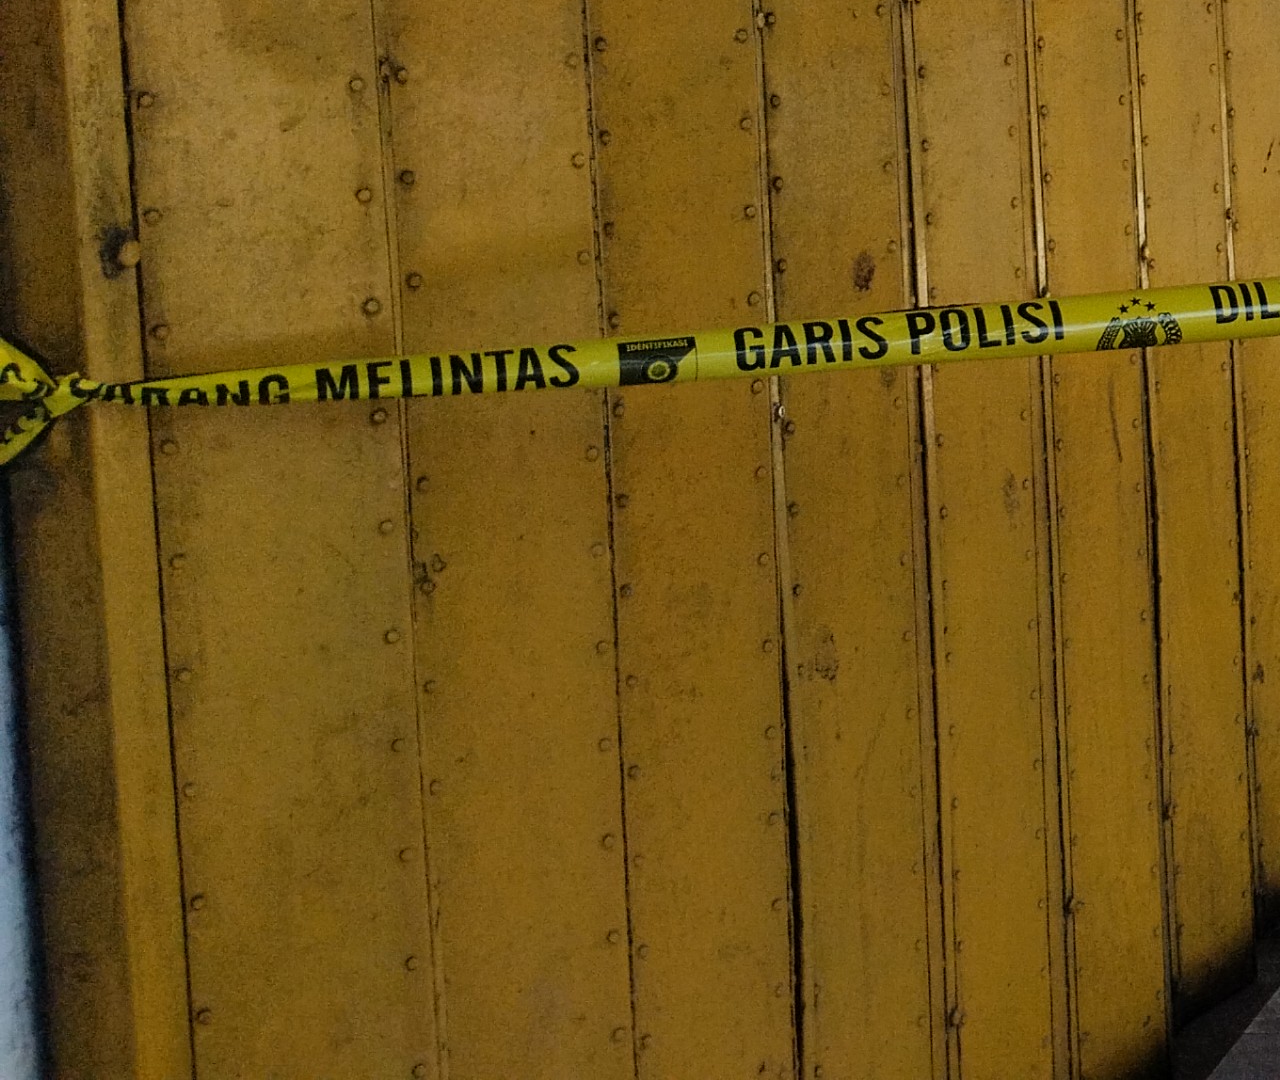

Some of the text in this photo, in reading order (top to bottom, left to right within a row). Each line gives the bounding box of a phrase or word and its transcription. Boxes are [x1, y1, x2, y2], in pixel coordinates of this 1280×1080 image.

[626, 339, 688, 352] IDENTIFIKASI
[733, 299, 1066, 372] GARIS POLISI
[314, 343, 581, 402] MELINTAS
